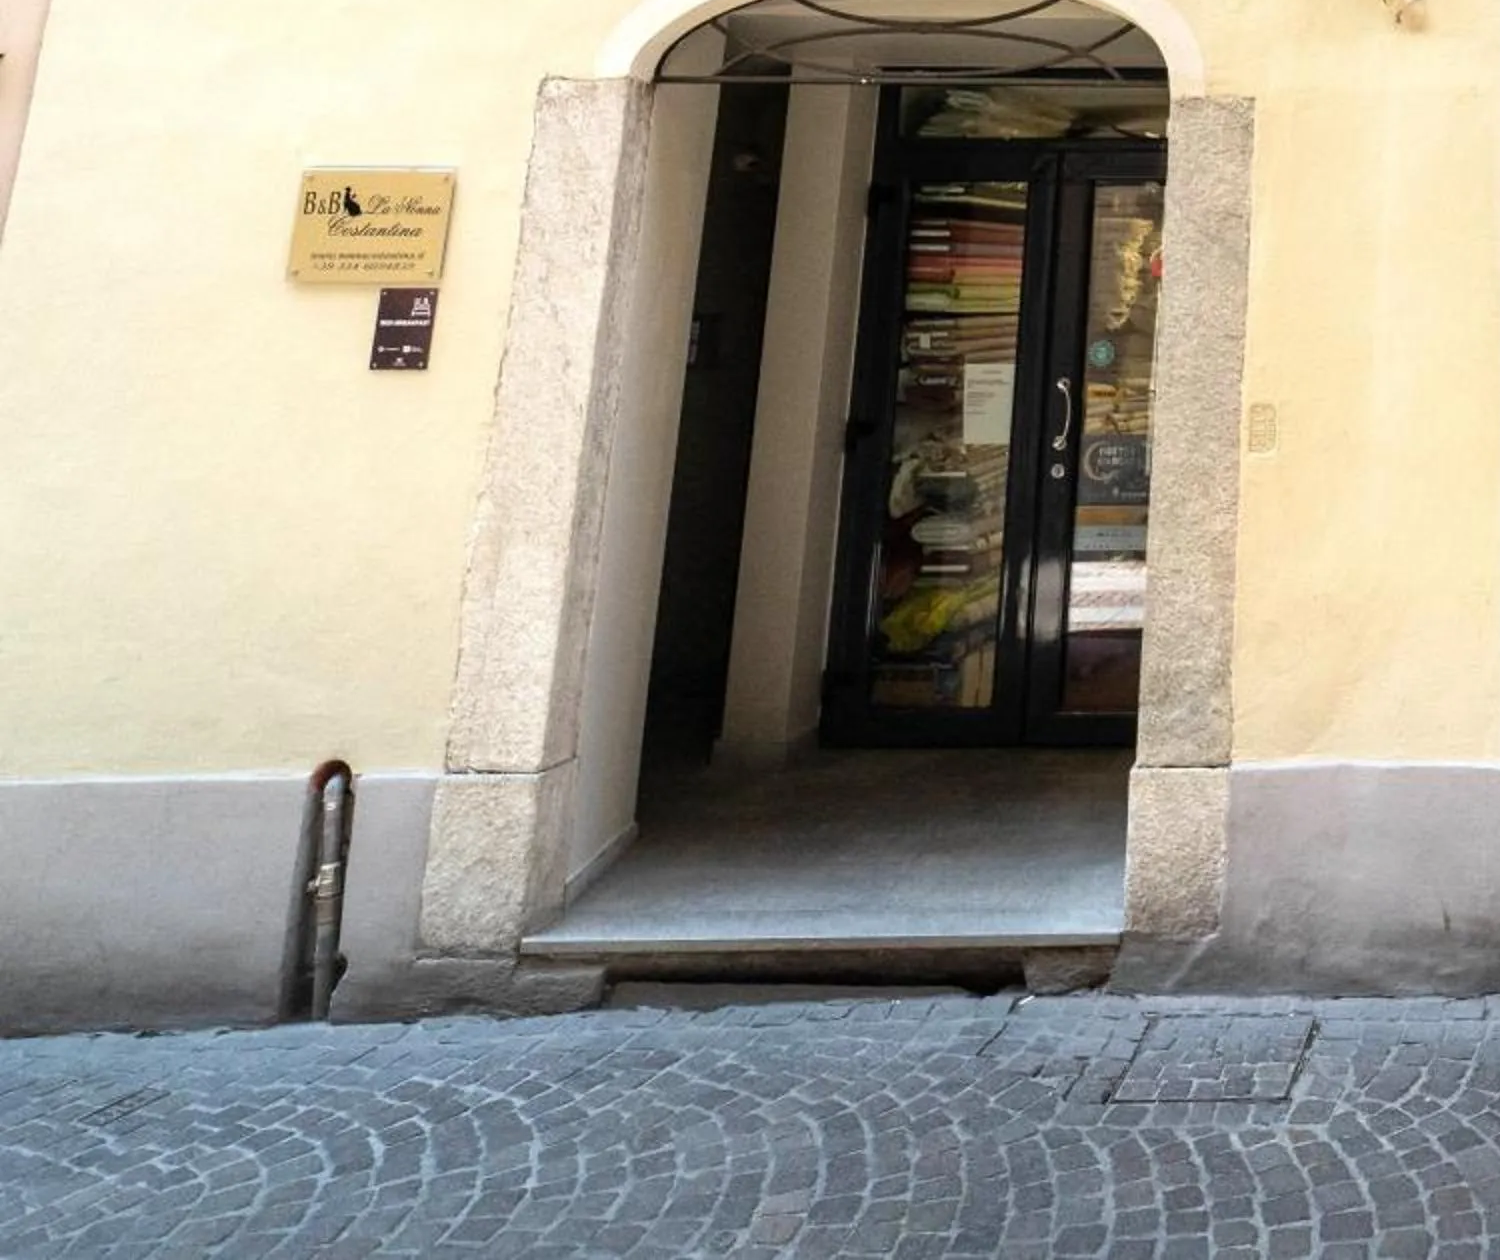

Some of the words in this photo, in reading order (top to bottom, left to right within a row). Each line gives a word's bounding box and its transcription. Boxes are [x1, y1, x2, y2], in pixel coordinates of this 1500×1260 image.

[303, 191, 341, 215] B&B
[362, 194, 391, 215] La
[394, 195, 441, 215] Nonna
[327, 214, 423, 237] Costantina
